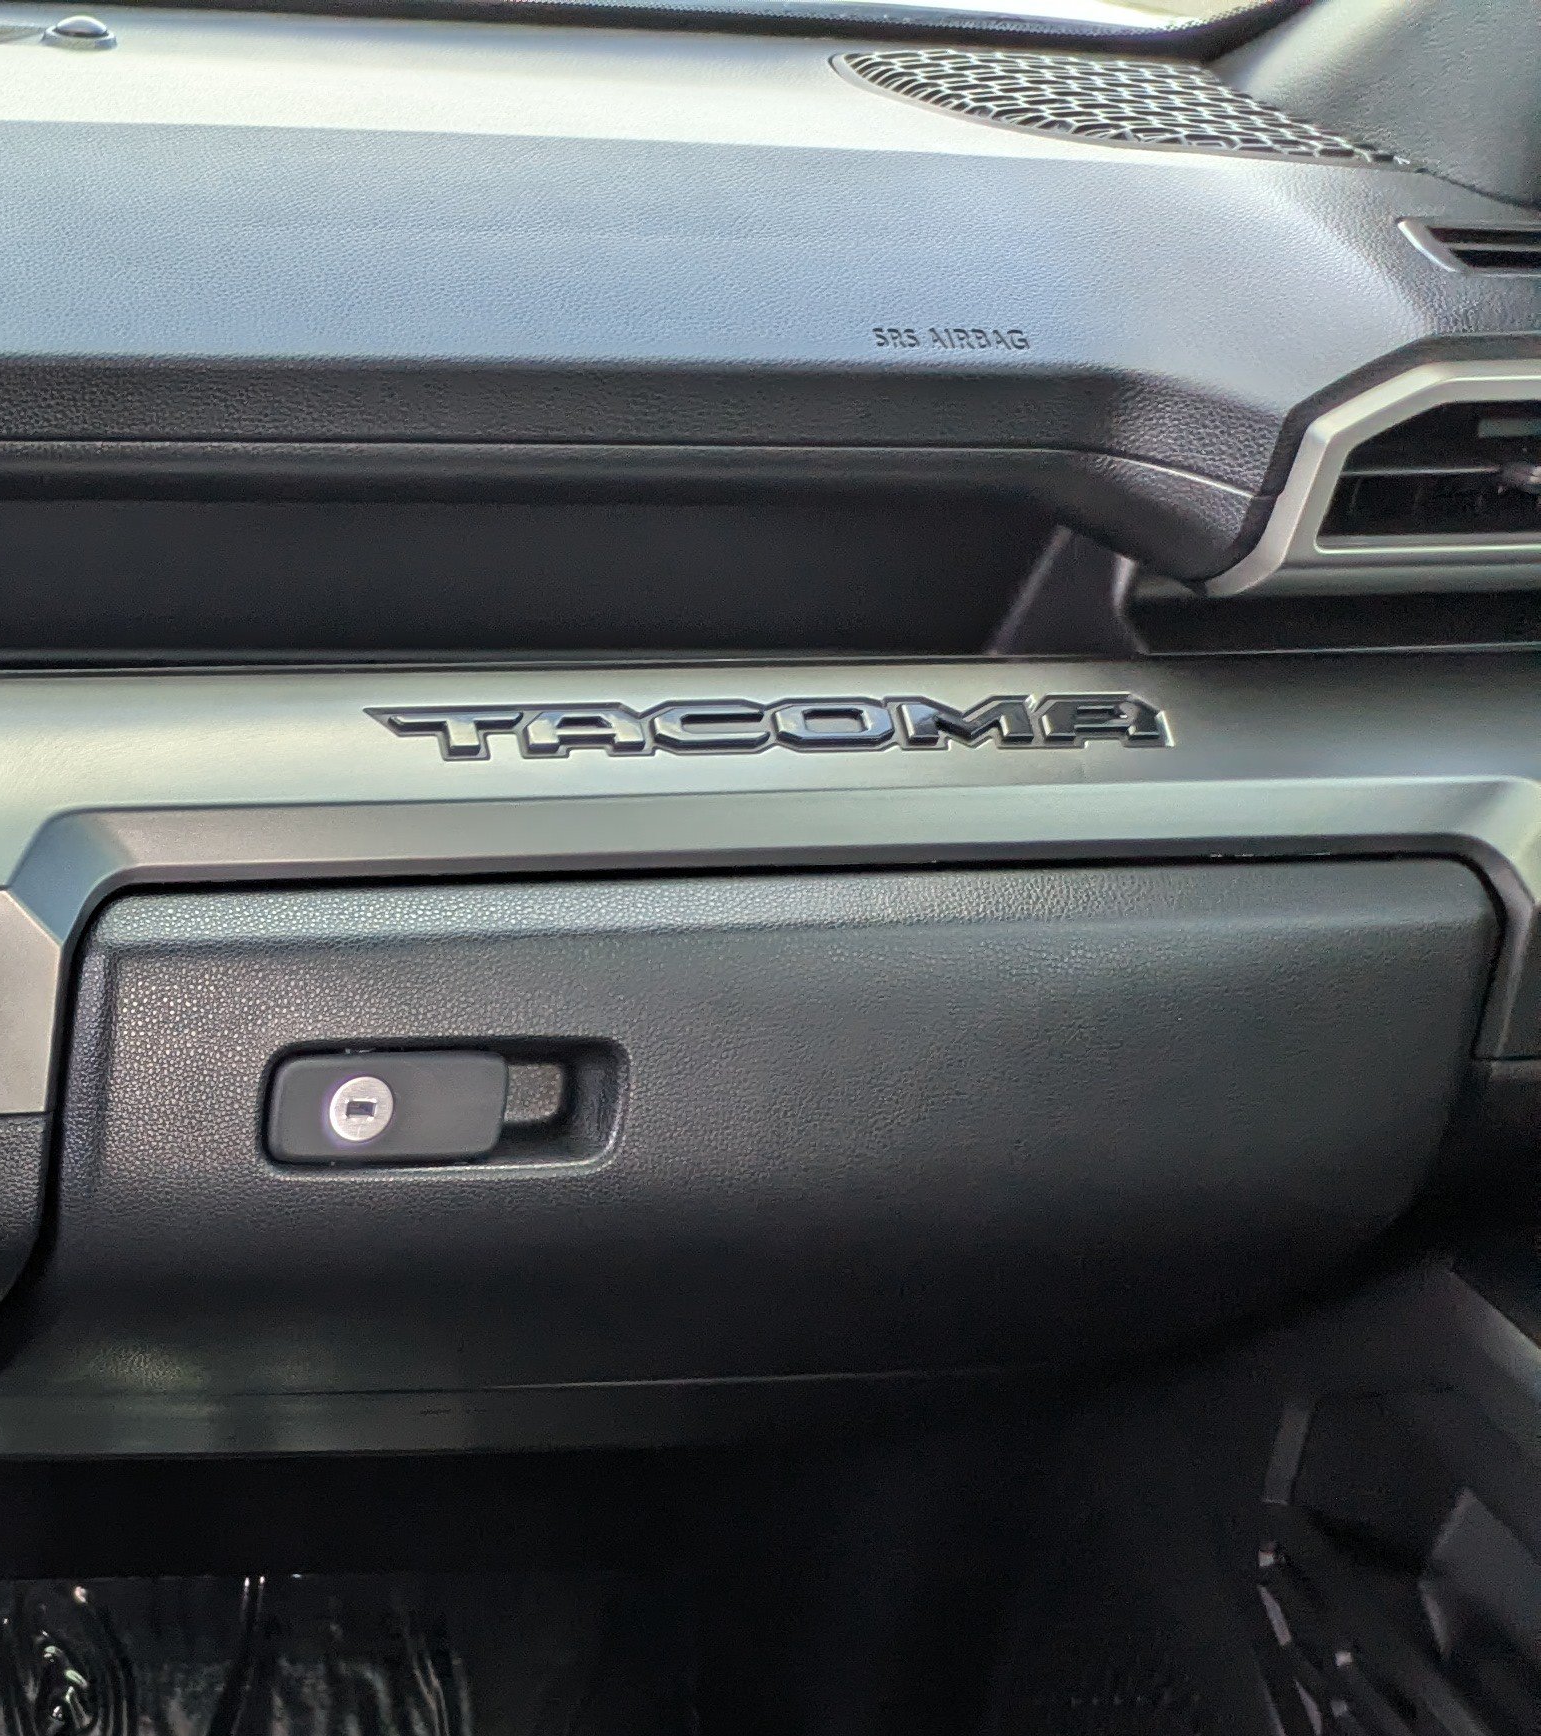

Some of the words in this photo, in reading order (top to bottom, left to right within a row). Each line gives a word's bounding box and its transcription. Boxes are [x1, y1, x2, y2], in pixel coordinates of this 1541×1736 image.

[872, 327, 920, 347] SRS
[928, 327, 1030, 350] AIRBAG
[364, 693, 1173, 761] TACOMA
